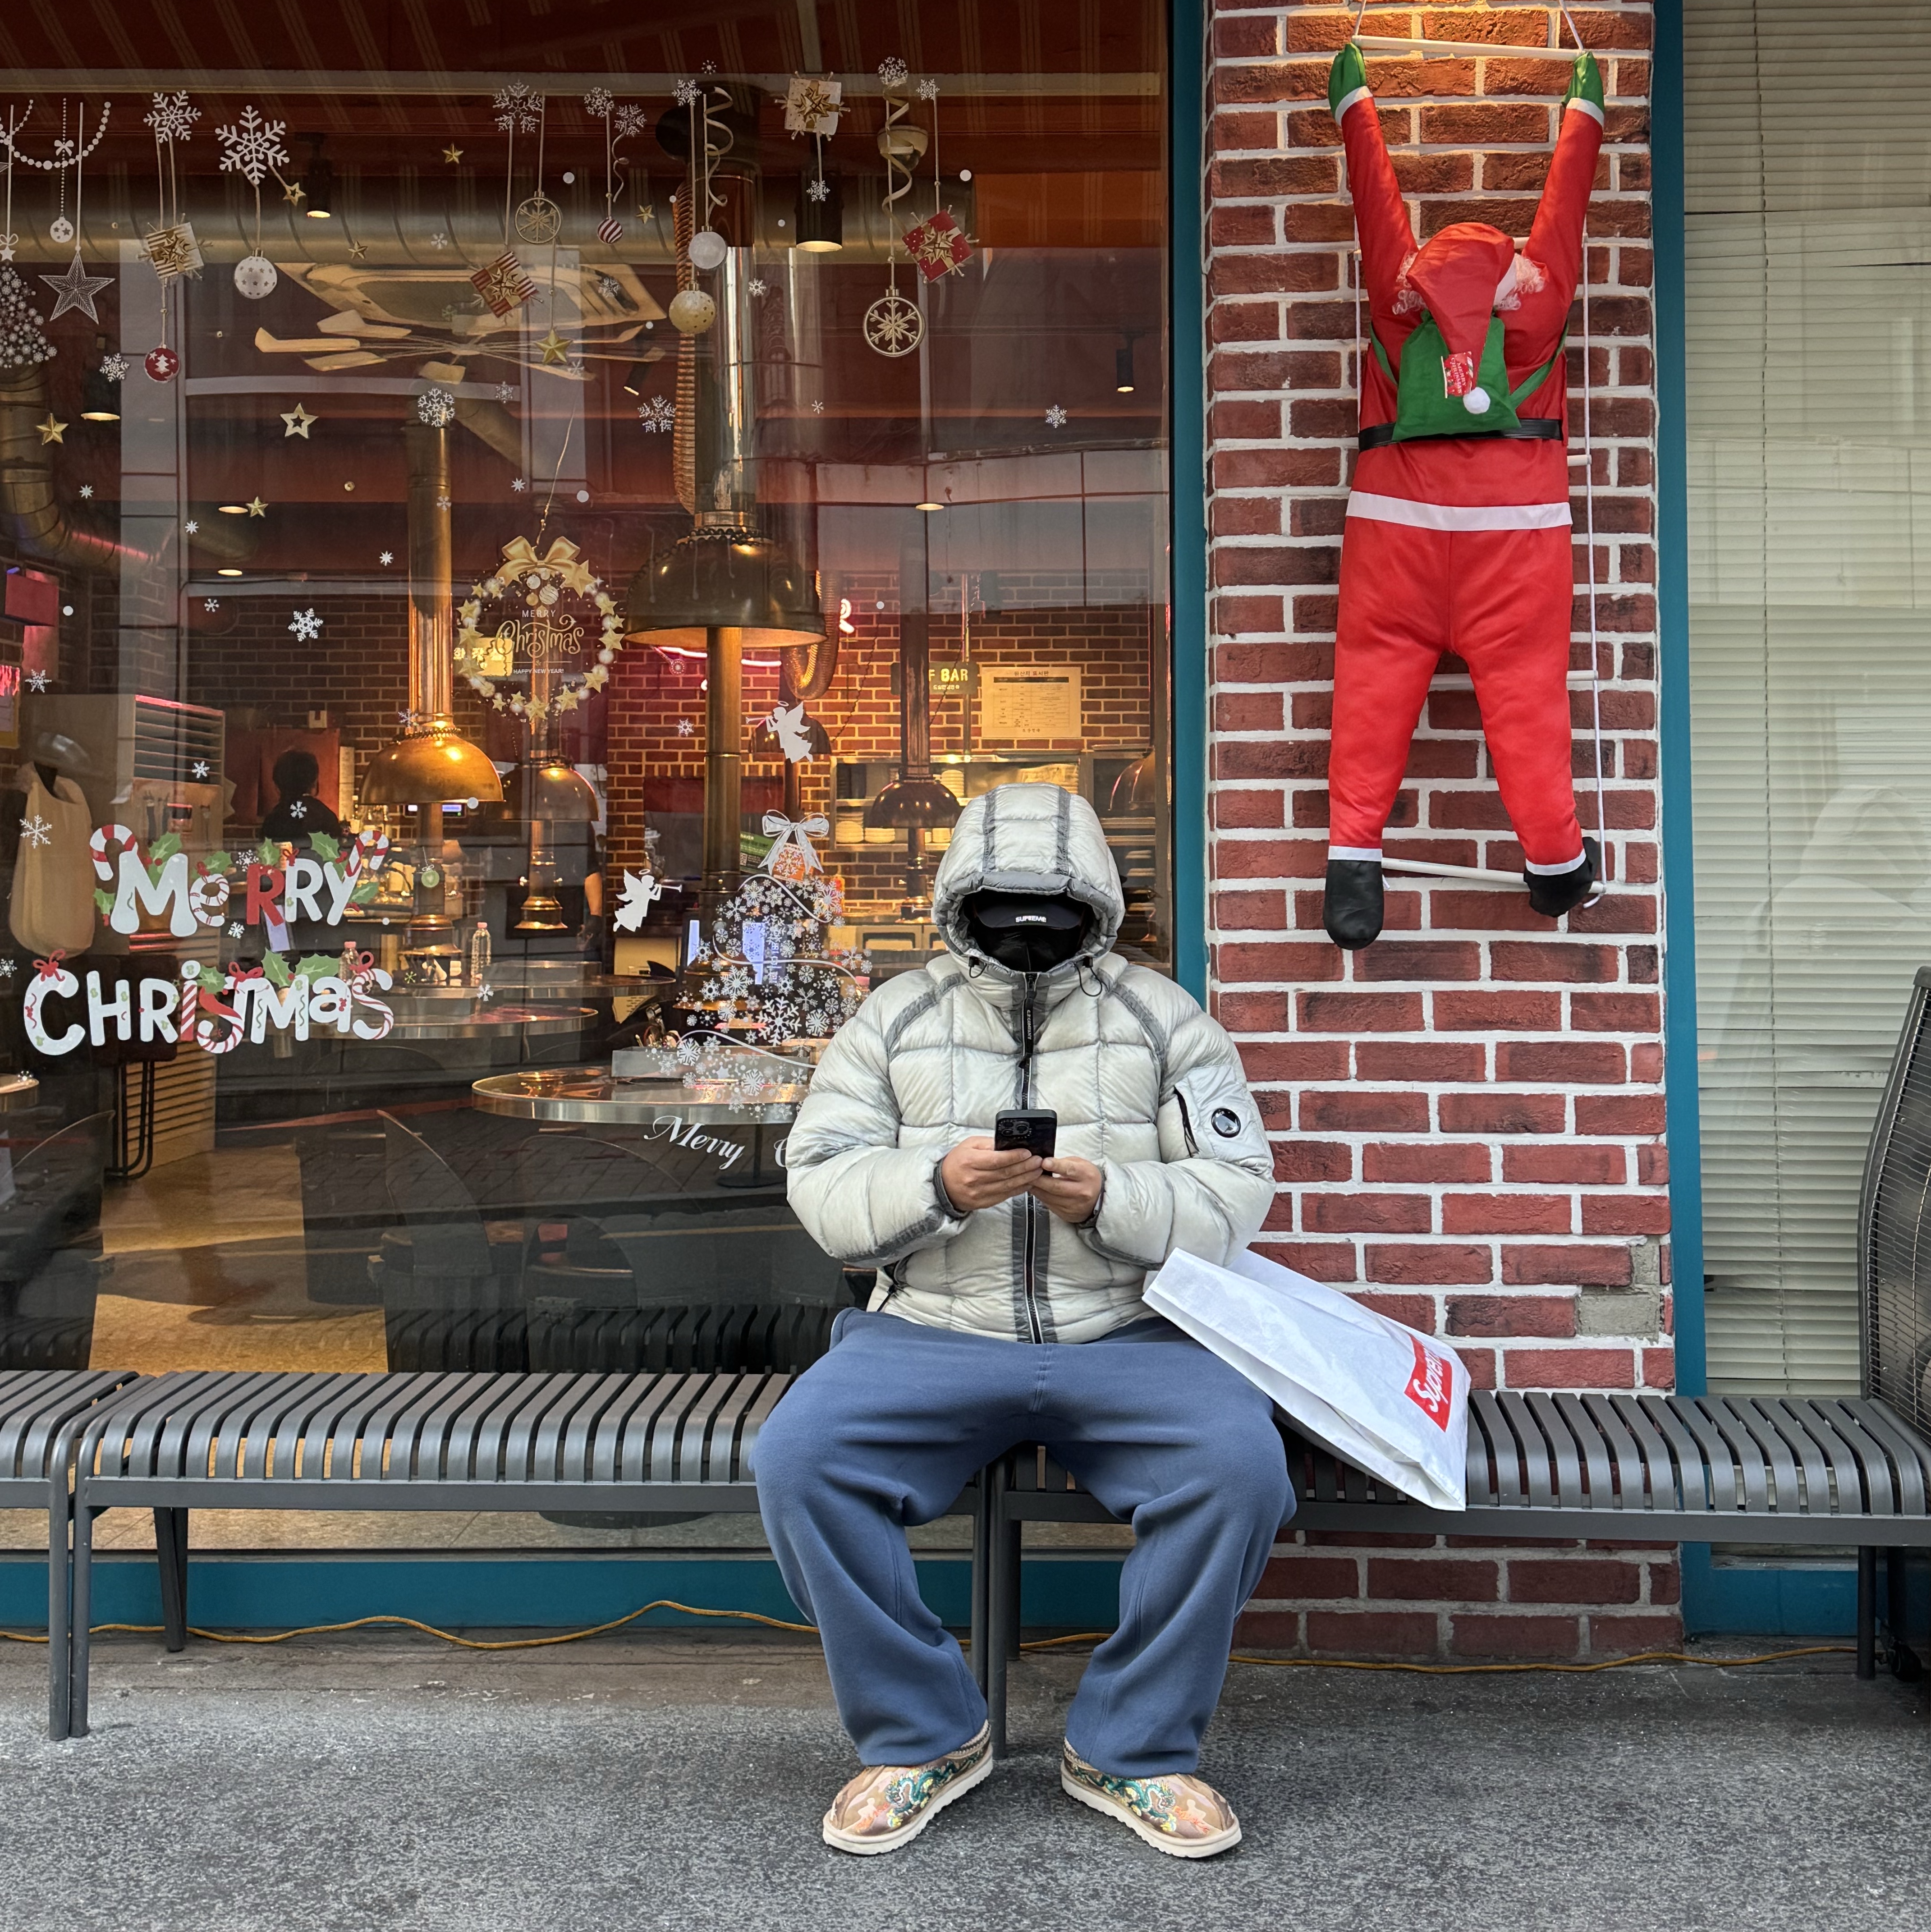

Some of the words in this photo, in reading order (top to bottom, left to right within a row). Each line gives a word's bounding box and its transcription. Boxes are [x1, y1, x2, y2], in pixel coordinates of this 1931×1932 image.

[522, 610, 556, 618] MERRY
[496, 614, 584, 658] Christmas
[941, 668, 968, 682] BAR
[644, 1115, 745, 1170] Merry
